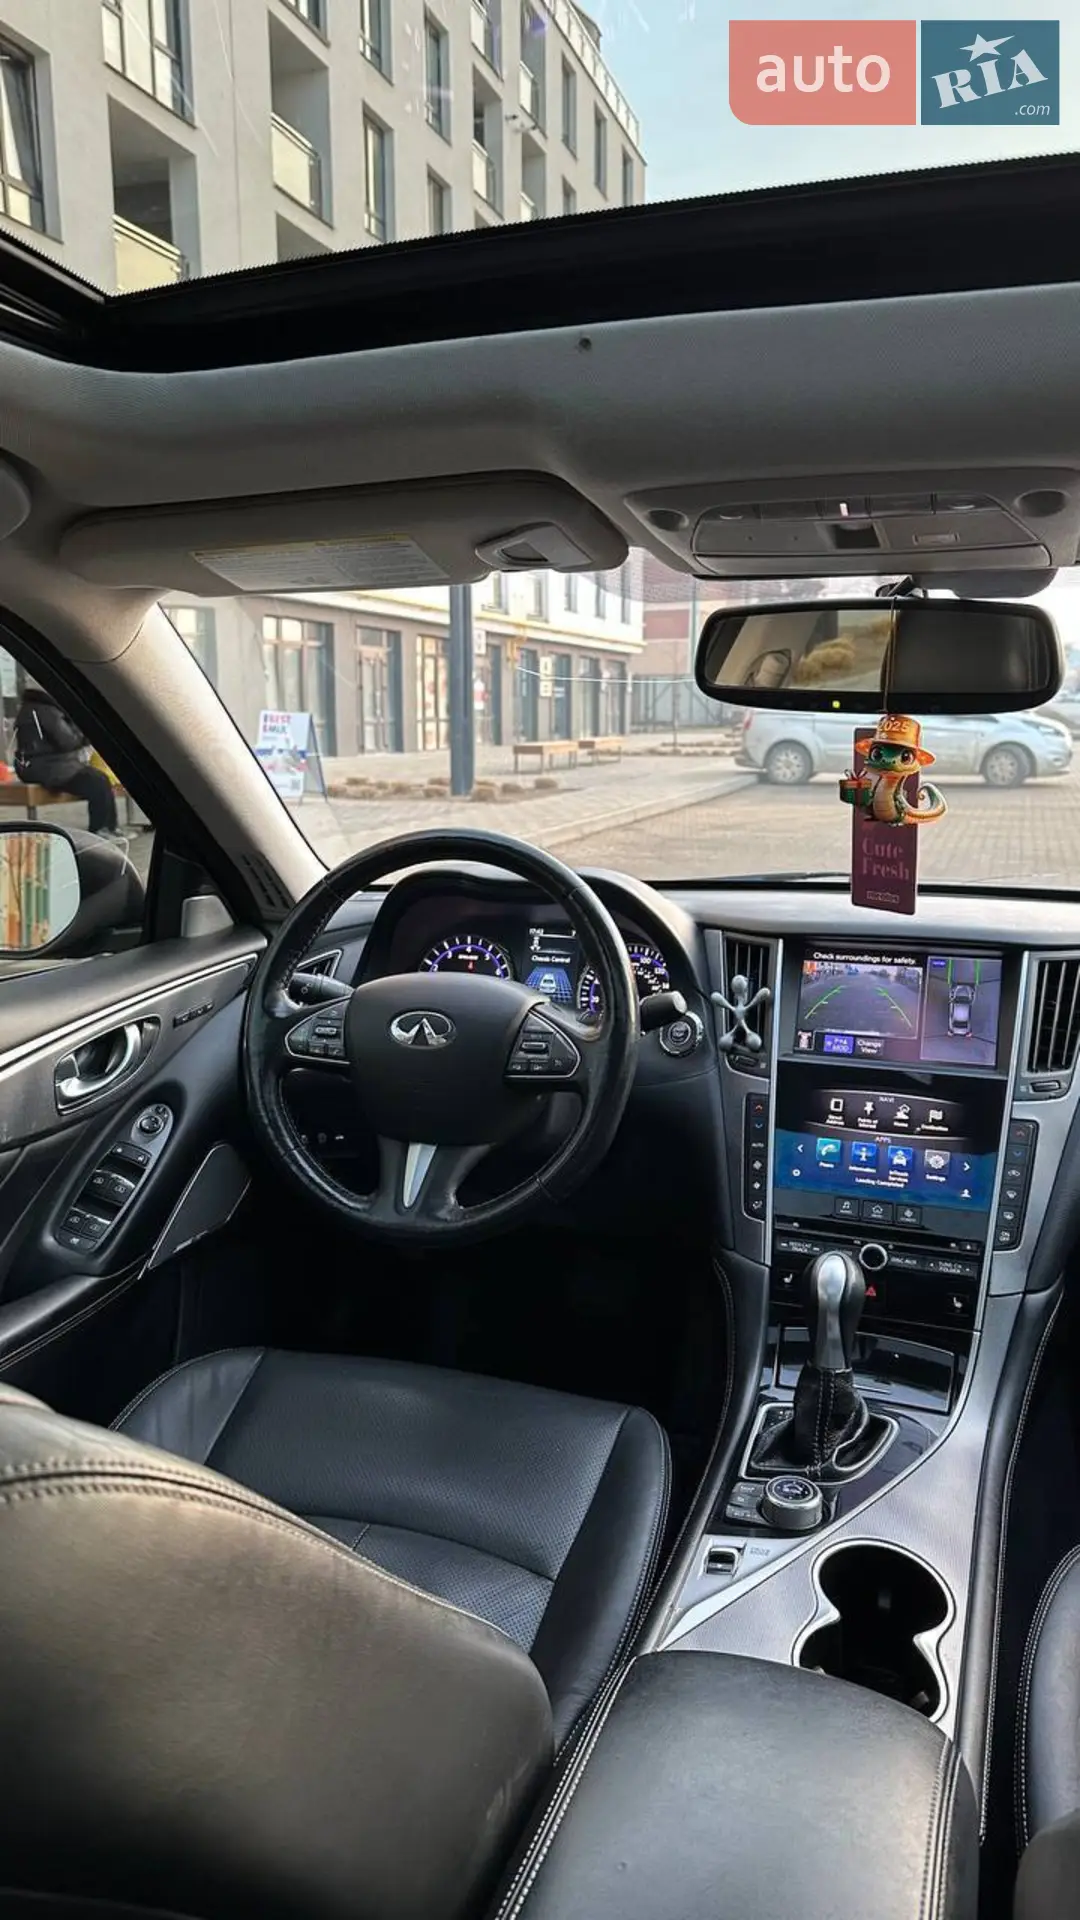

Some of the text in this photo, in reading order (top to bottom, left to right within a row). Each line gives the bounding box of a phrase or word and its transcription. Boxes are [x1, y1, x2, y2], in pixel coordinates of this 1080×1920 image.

[879, 720, 910, 733] 2025
[862, 837, 904, 859] Cute
[862, 857, 910, 881] Fresh
[813, 952, 834, 960] Check
[835, 953, 880, 964] surroundings
[881, 955, 893, 963] for
